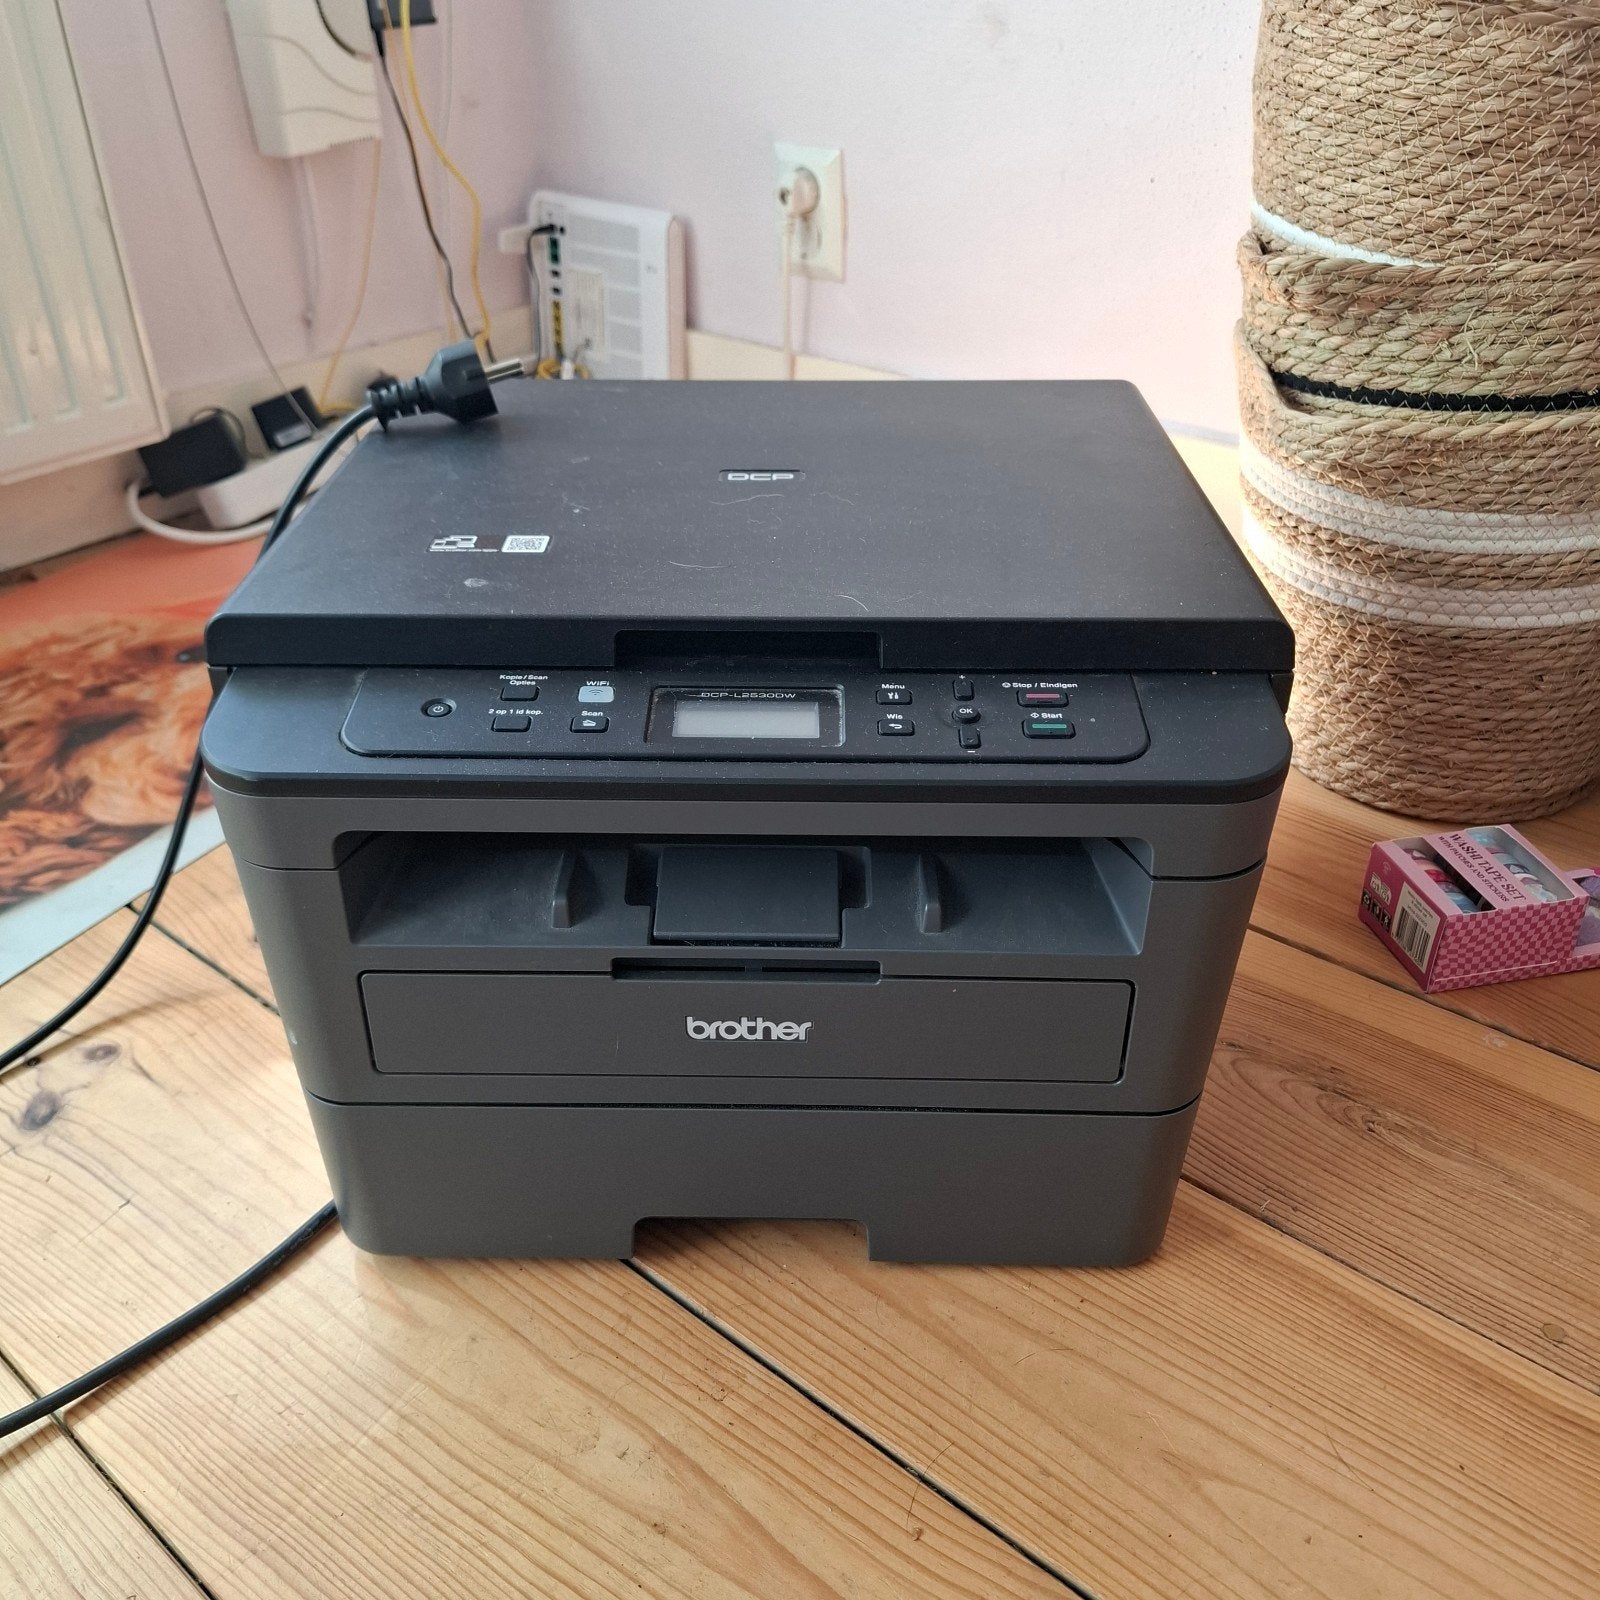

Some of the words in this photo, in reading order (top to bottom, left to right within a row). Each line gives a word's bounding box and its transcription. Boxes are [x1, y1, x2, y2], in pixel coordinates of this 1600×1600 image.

[728, 473, 794, 481] DCP
[1438, 836, 1454, 850] WITH
[1450, 848, 1474, 869] PATCHES
[1472, 868, 1485, 879] AND
[1483, 878, 1509, 902] STICKERS
[1450, 833, 1483, 860] WASHI
[1478, 860, 1507, 883] TAPE
[1501, 883, 1526, 900] SET
[685, 1016, 813, 1041] brother
